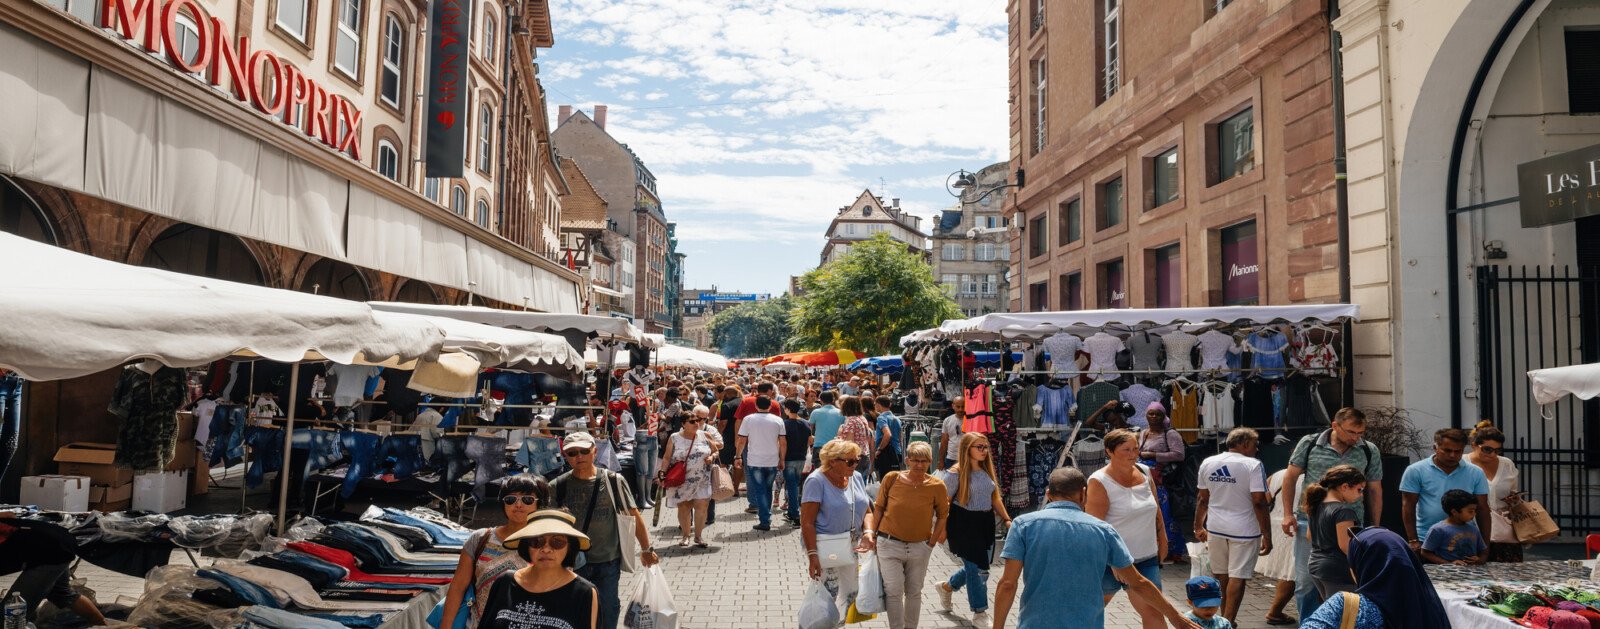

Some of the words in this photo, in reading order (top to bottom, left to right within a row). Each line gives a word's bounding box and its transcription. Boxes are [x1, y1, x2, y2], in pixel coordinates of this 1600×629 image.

[101, 0, 362, 161] MONOPRIX
[1545, 172, 1580, 194] Les
[1208, 475, 1237, 484] adidas
